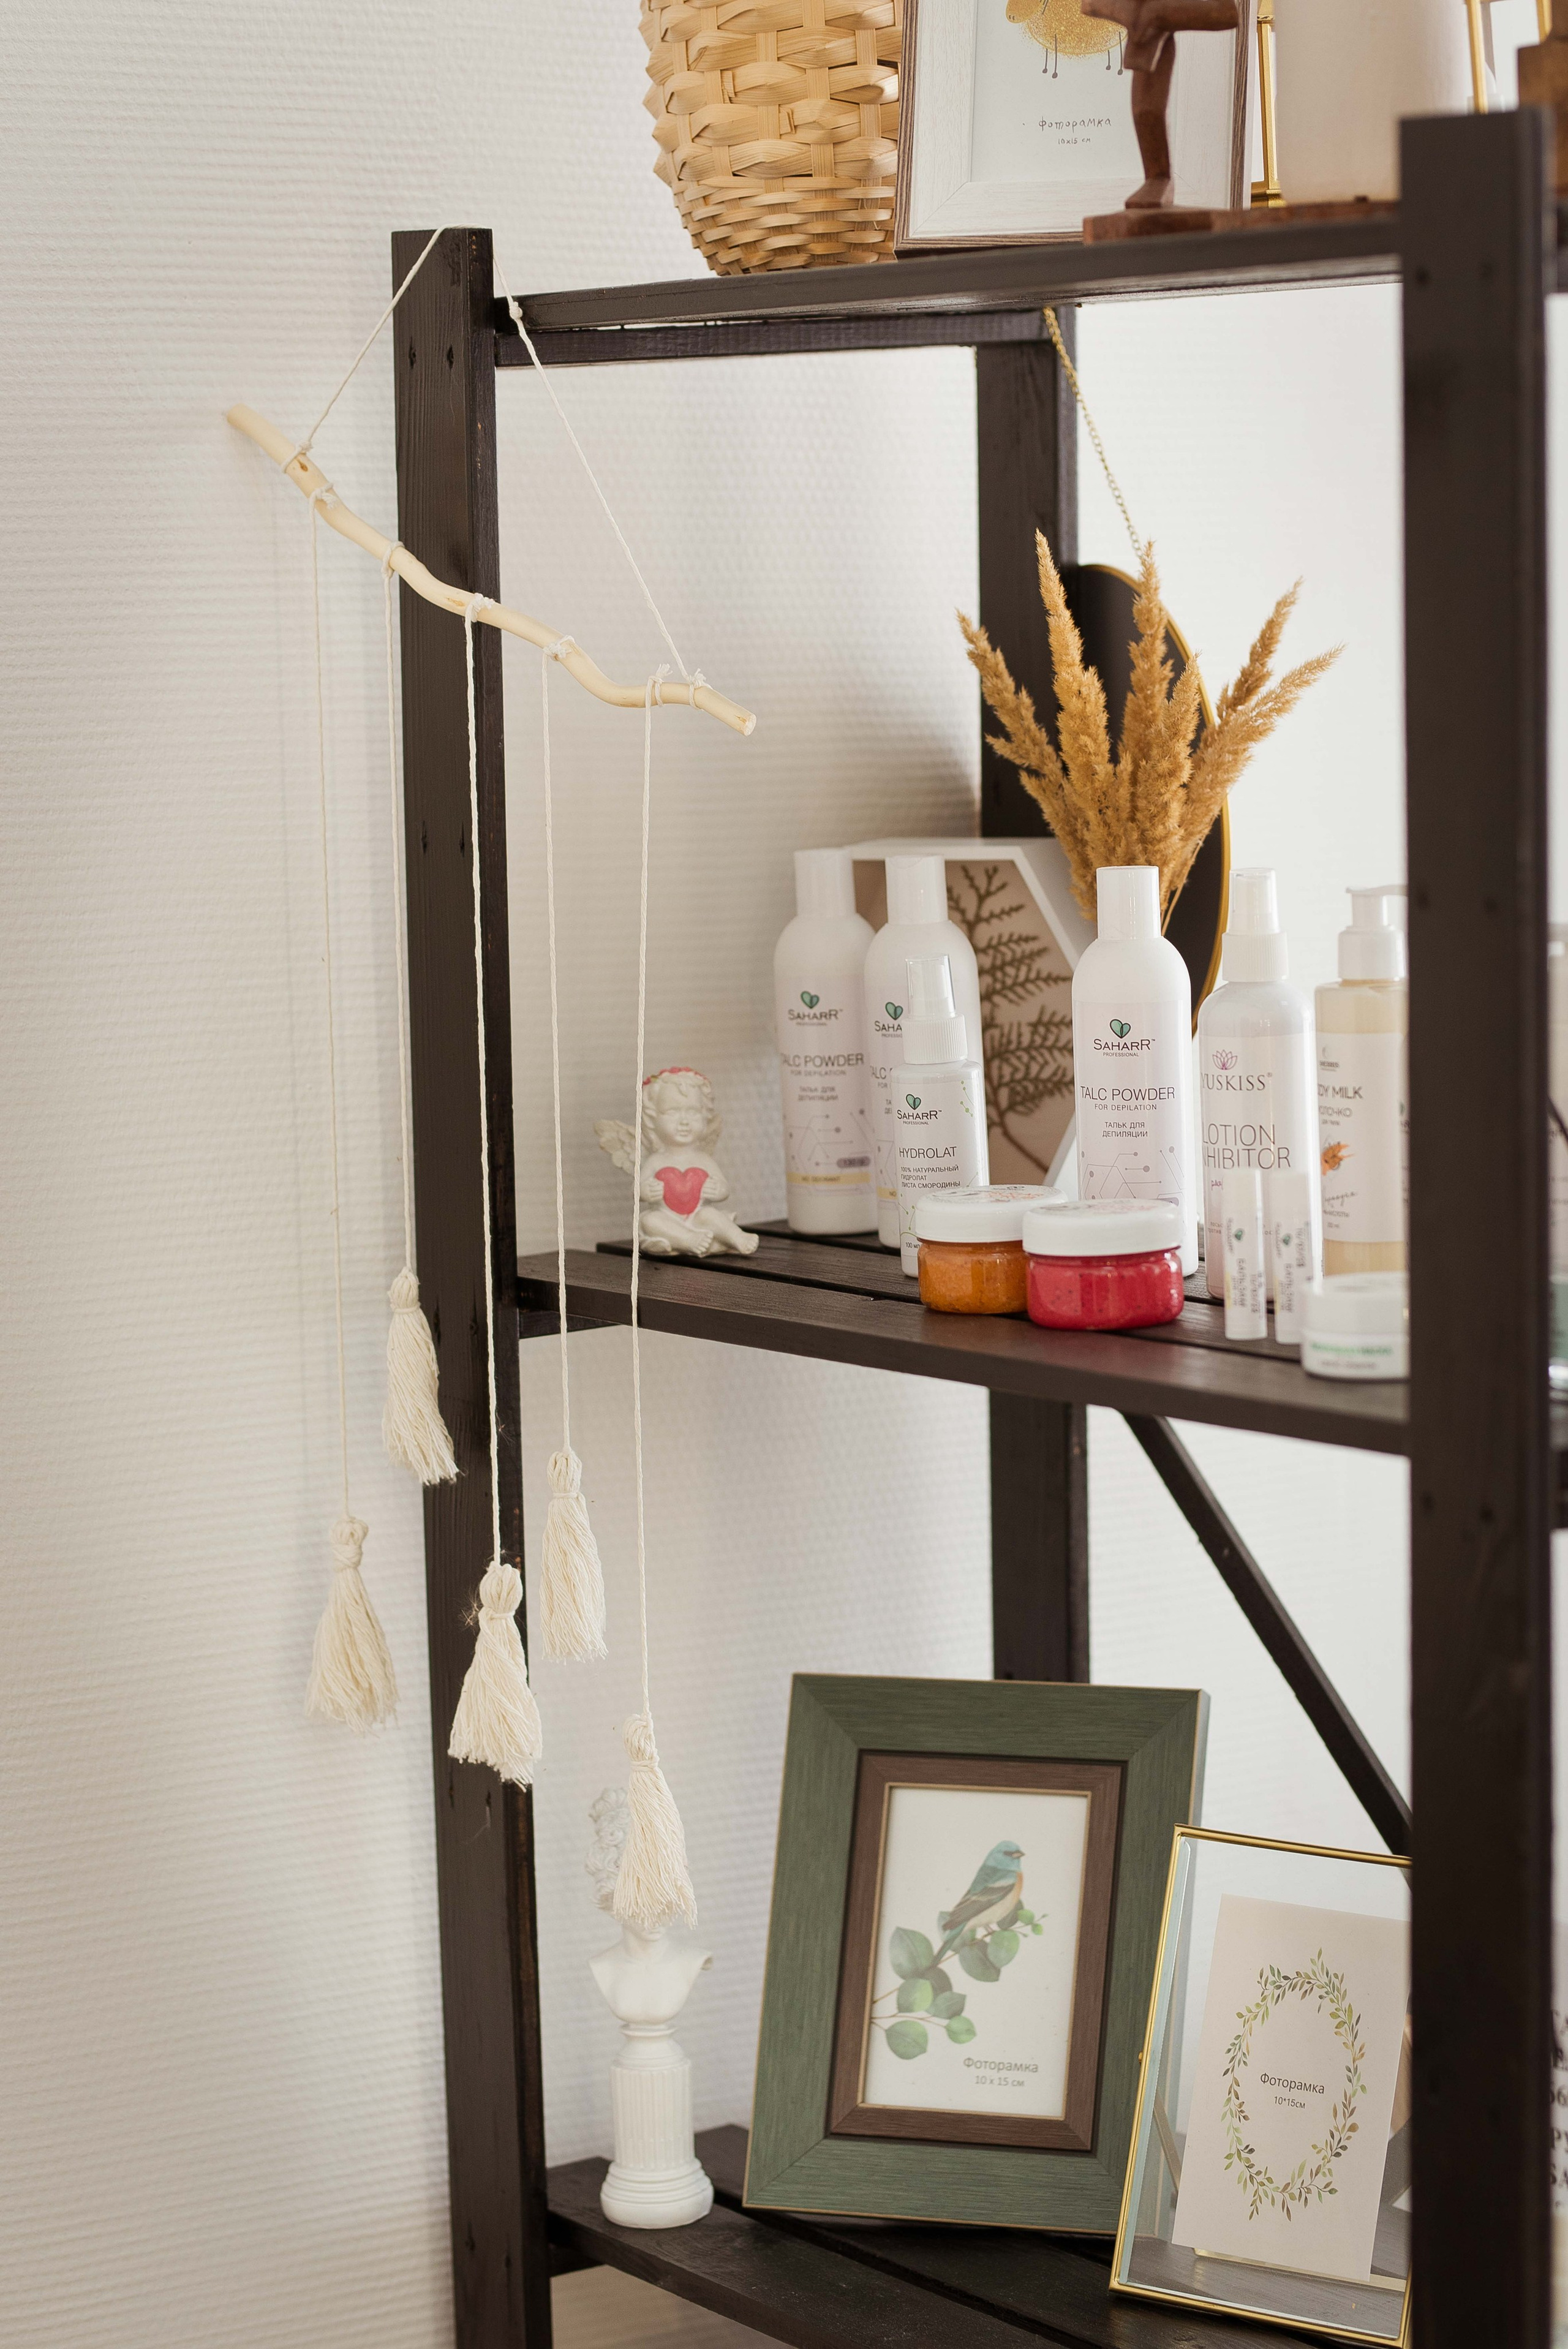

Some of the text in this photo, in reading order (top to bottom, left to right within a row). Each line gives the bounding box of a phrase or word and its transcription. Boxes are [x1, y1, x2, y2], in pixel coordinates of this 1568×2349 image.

[875, 1020, 902, 1032] SAHA
[804, 1052, 864, 1068] POWDER
[1080, 1086, 1175, 1101] TALC POWDER
[1332, 1085, 1364, 1099] MILK
[1202, 1123, 1275, 1147] LOTION
[899, 1146, 957, 1159] HYDROLAT
[913, 1164, 959, 1173] НАТУРАЛЬНЫЙ
[963, 2057, 1039, 2073] Фоторамка
[975, 2075, 987, 2084] 10
[997, 2077, 1009, 2086] 15
[1261, 2072, 1325, 2095] Фоторамка
